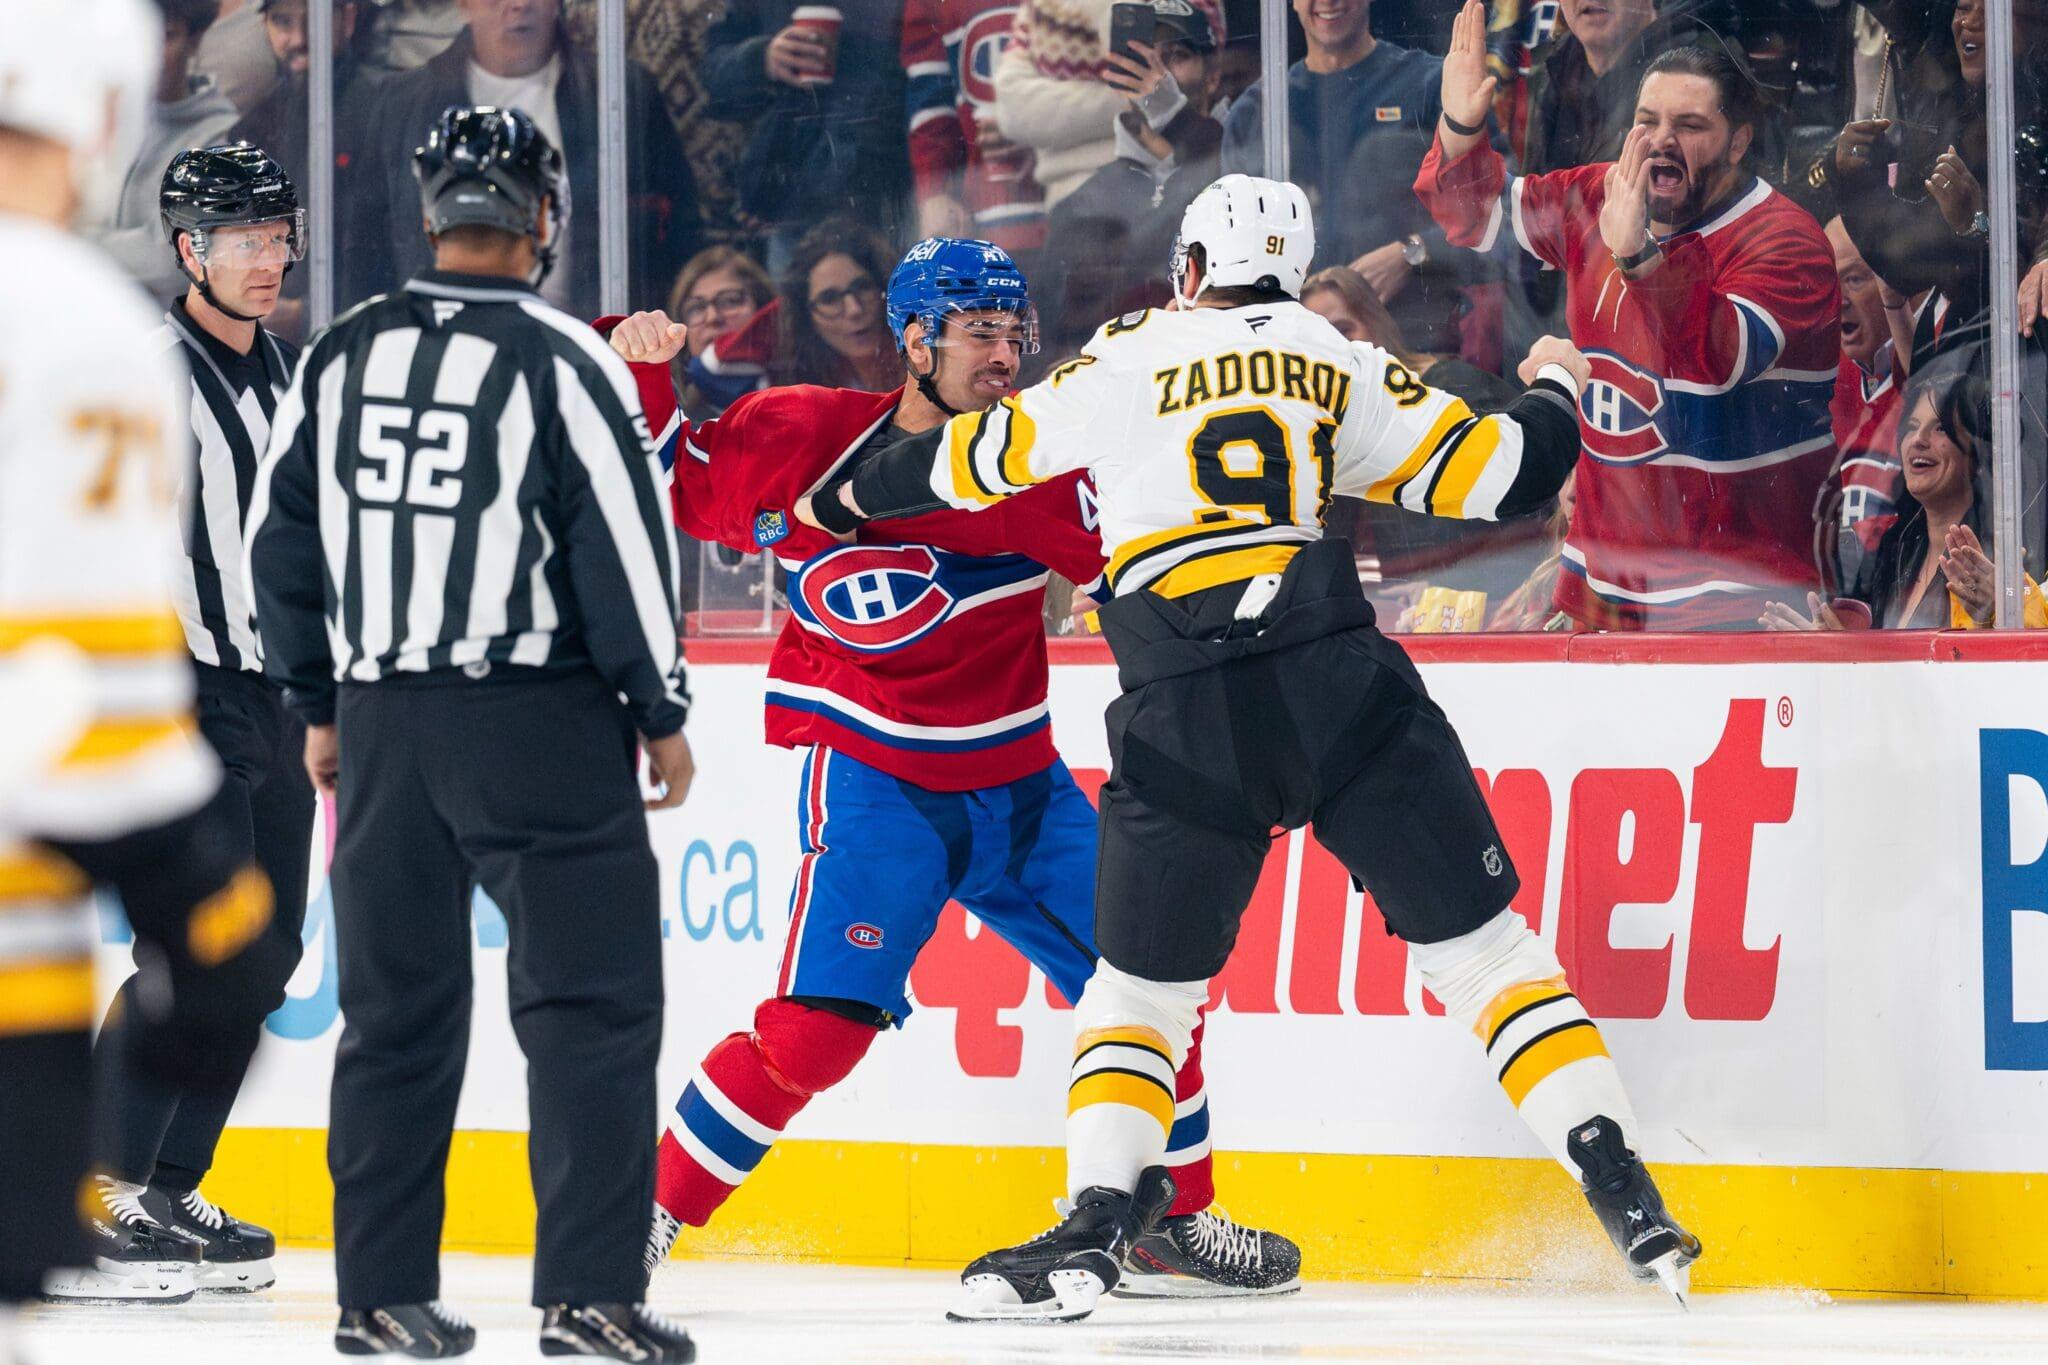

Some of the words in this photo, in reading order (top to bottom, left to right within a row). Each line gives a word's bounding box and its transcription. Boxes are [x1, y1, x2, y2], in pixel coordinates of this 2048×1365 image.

[903, 240, 944, 263] Bell
[1266, 235, 1285, 256] 91
[987, 277, 1020, 288] CCM
[355, 403, 470, 509] 52
[1186, 404, 1336, 528] 91
[758, 525, 785, 543] RBC
[581, 1306, 649, 1361] CCM
